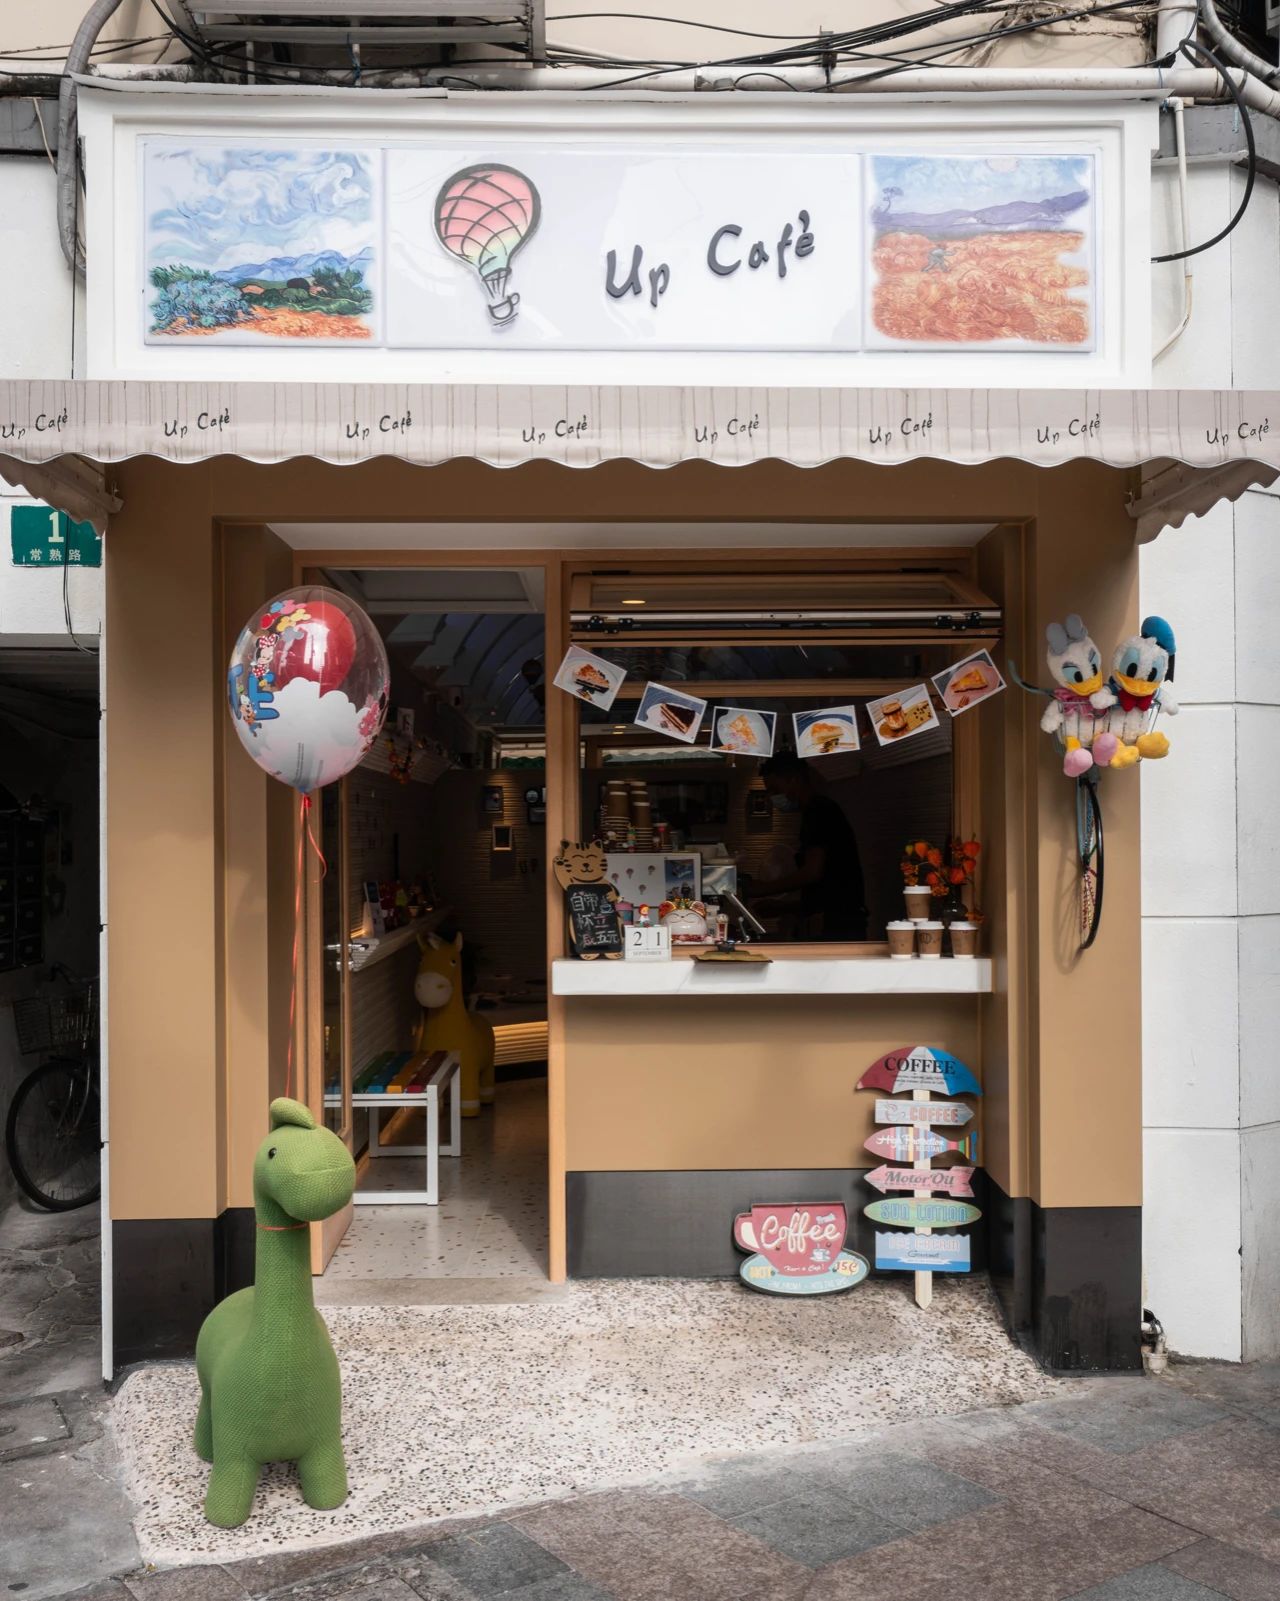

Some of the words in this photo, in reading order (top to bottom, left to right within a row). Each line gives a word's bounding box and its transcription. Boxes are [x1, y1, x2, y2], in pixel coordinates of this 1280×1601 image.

[606, 244, 670, 308] Up
[2, 423, 26, 440] Up
[164, 419, 188, 439] Up
[346, 421, 370, 441] Up
[522, 426, 546, 444] Up
[694, 425, 718, 444] Up
[869, 425, 892, 445] Up
[1037, 425, 1060, 445] Up
[1206, 427, 1230, 447] Up
[29, 547, 81, 562] 常熟路
[884, 1056, 956, 1075] COFFEE
[909, 1105, 958, 1123] COFFEE
[884, 1171, 930, 1184] Motor
[760, 1211, 841, 1253] Coffee
